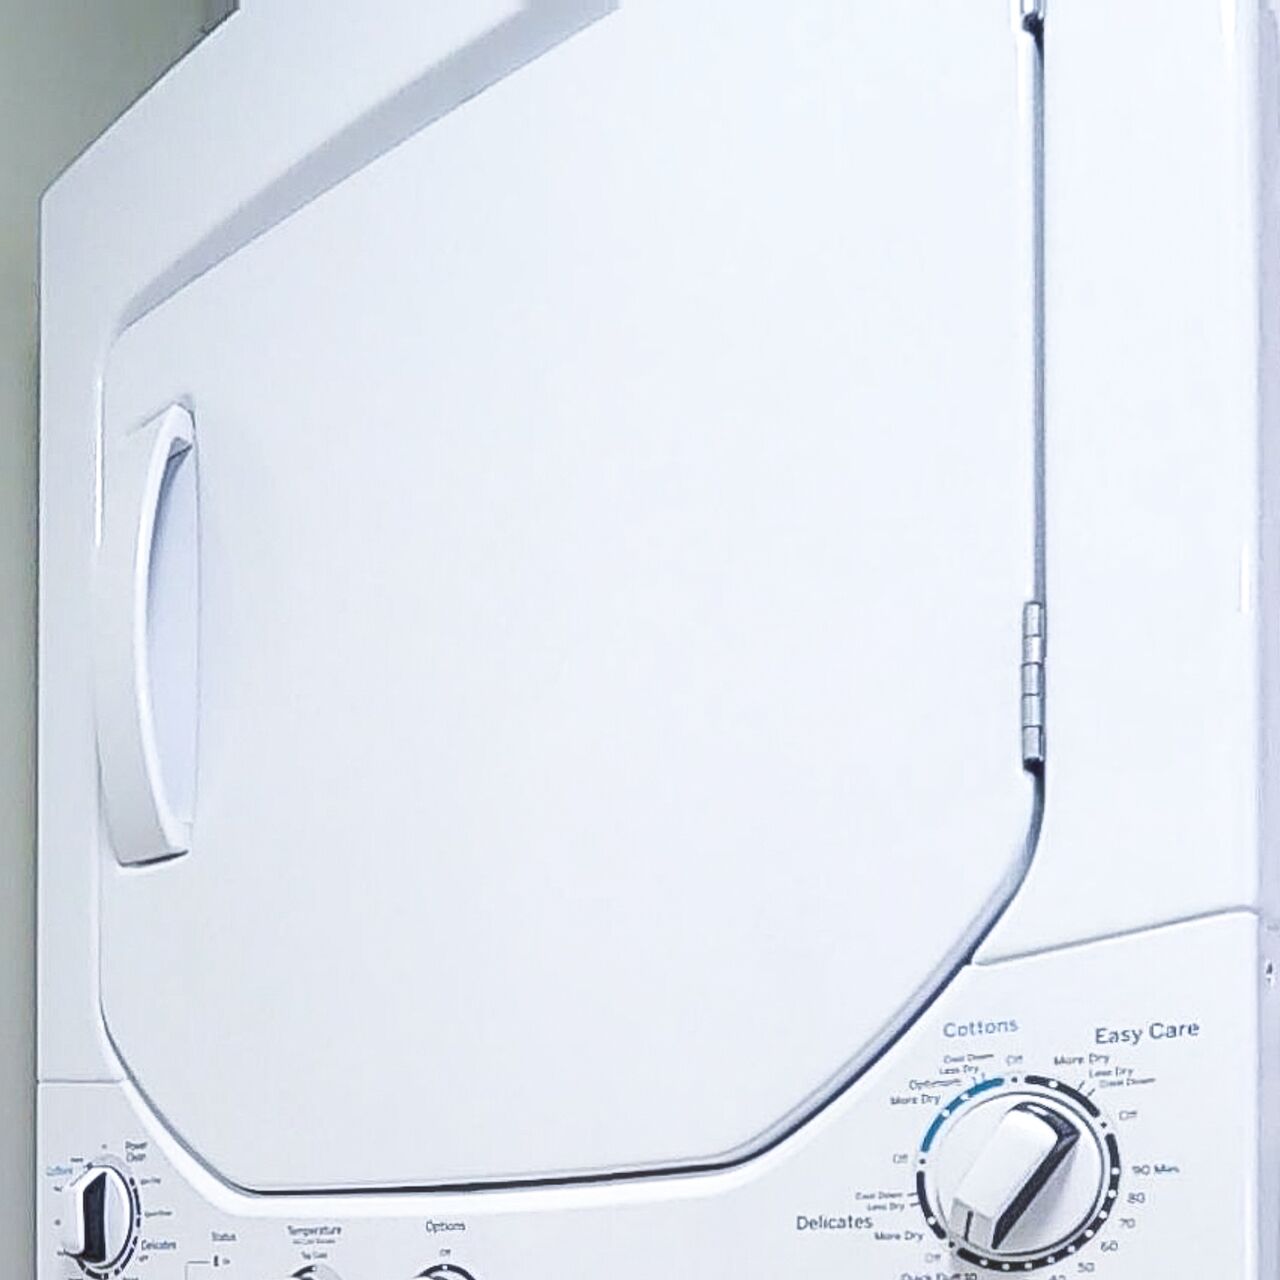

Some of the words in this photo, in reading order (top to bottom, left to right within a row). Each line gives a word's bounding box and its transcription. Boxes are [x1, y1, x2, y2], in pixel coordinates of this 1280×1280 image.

[943, 1019, 1018, 1038] Cottons
[1096, 1028, 1143, 1045] Easy
[1149, 1022, 1200, 1039] Care
[1054, 1056, 1084, 1065] More
[1089, 1053, 1110, 1064] Dry
[963, 1065, 978, 1075] Dry
[1115, 1066, 1134, 1077] Dry
[890, 1096, 917, 1105] More
[921, 1094, 941, 1106] Dry
[1132, 1165, 1150, 1176] 90
[1127, 1192, 1146, 1204] 80
[890, 1200, 905, 1212] Dry
[425, 1220, 466, 1234] Options
[796, 1215, 874, 1231] Delicates
[1119, 1218, 1136, 1229] 70
[904, 1230, 924, 1241] Dry
[1100, 1240, 1119, 1252] 60
